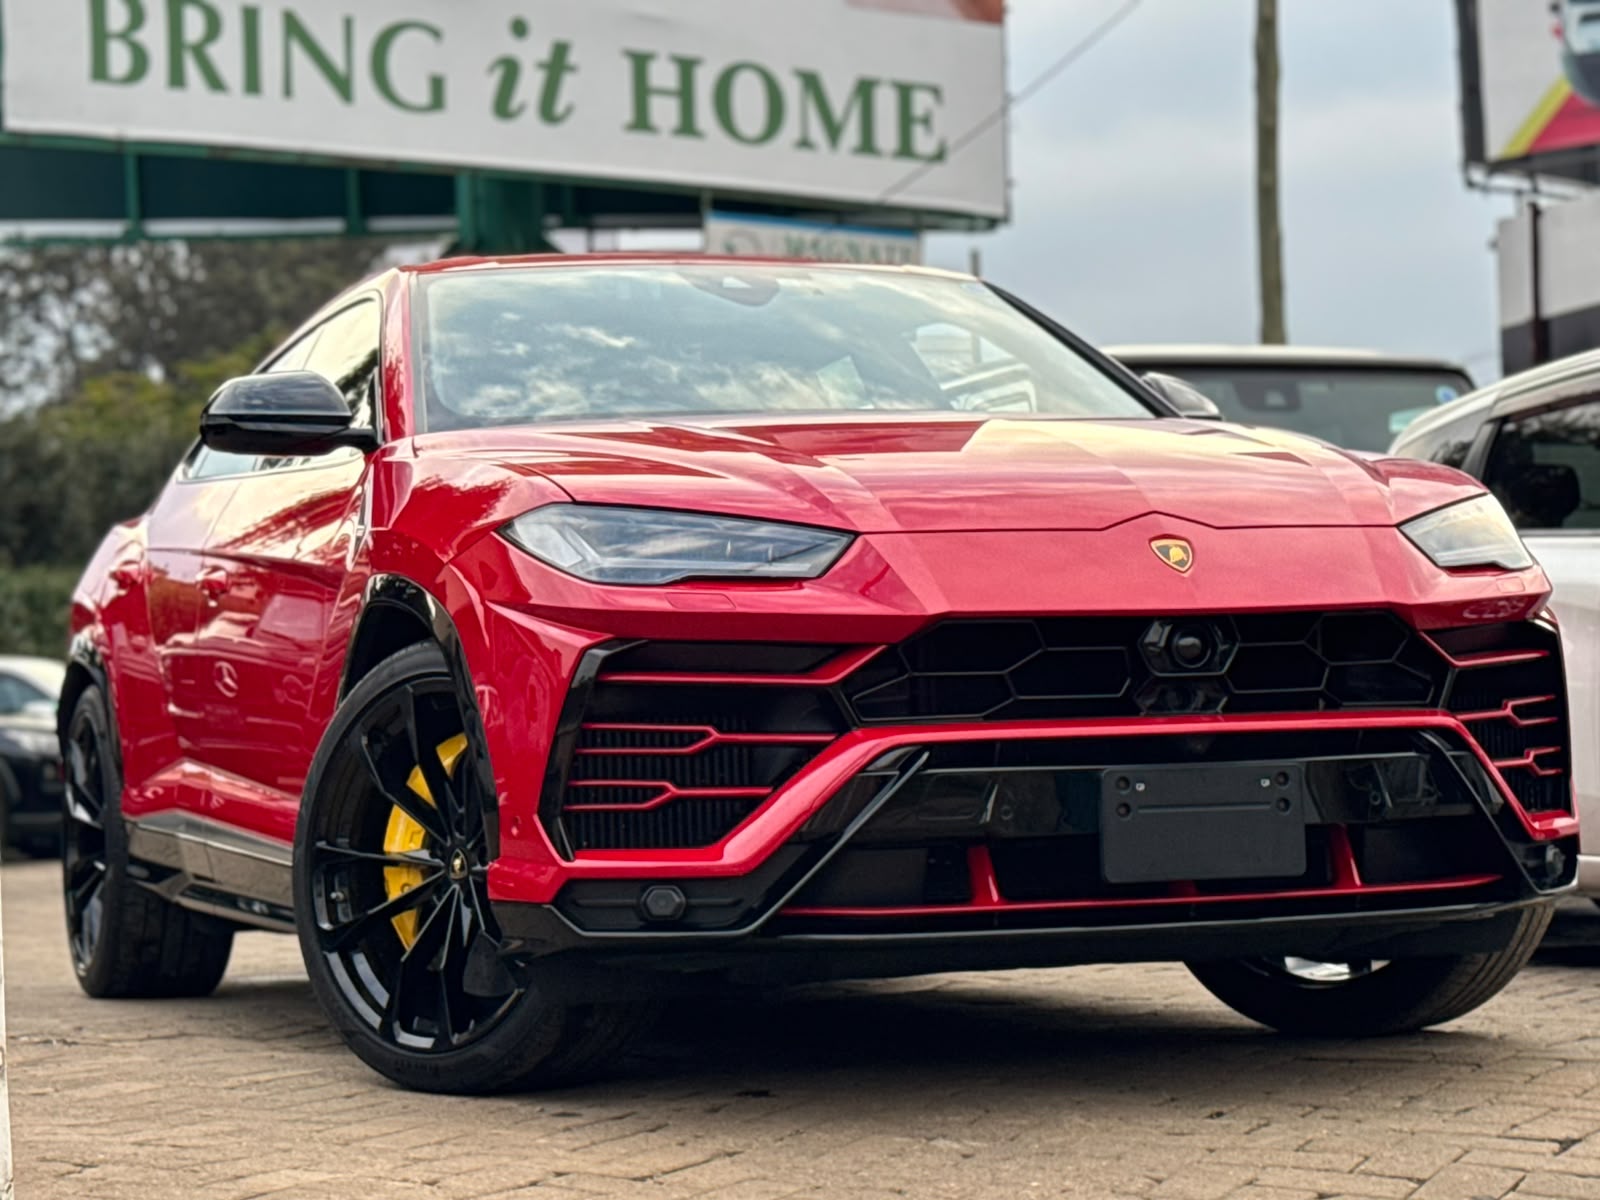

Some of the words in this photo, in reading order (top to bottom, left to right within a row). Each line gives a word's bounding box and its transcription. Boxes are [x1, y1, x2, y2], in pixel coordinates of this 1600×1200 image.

[89, 0, 446, 113] BRING
[487, 15, 579, 126] it
[621, 48, 947, 164] HOME
